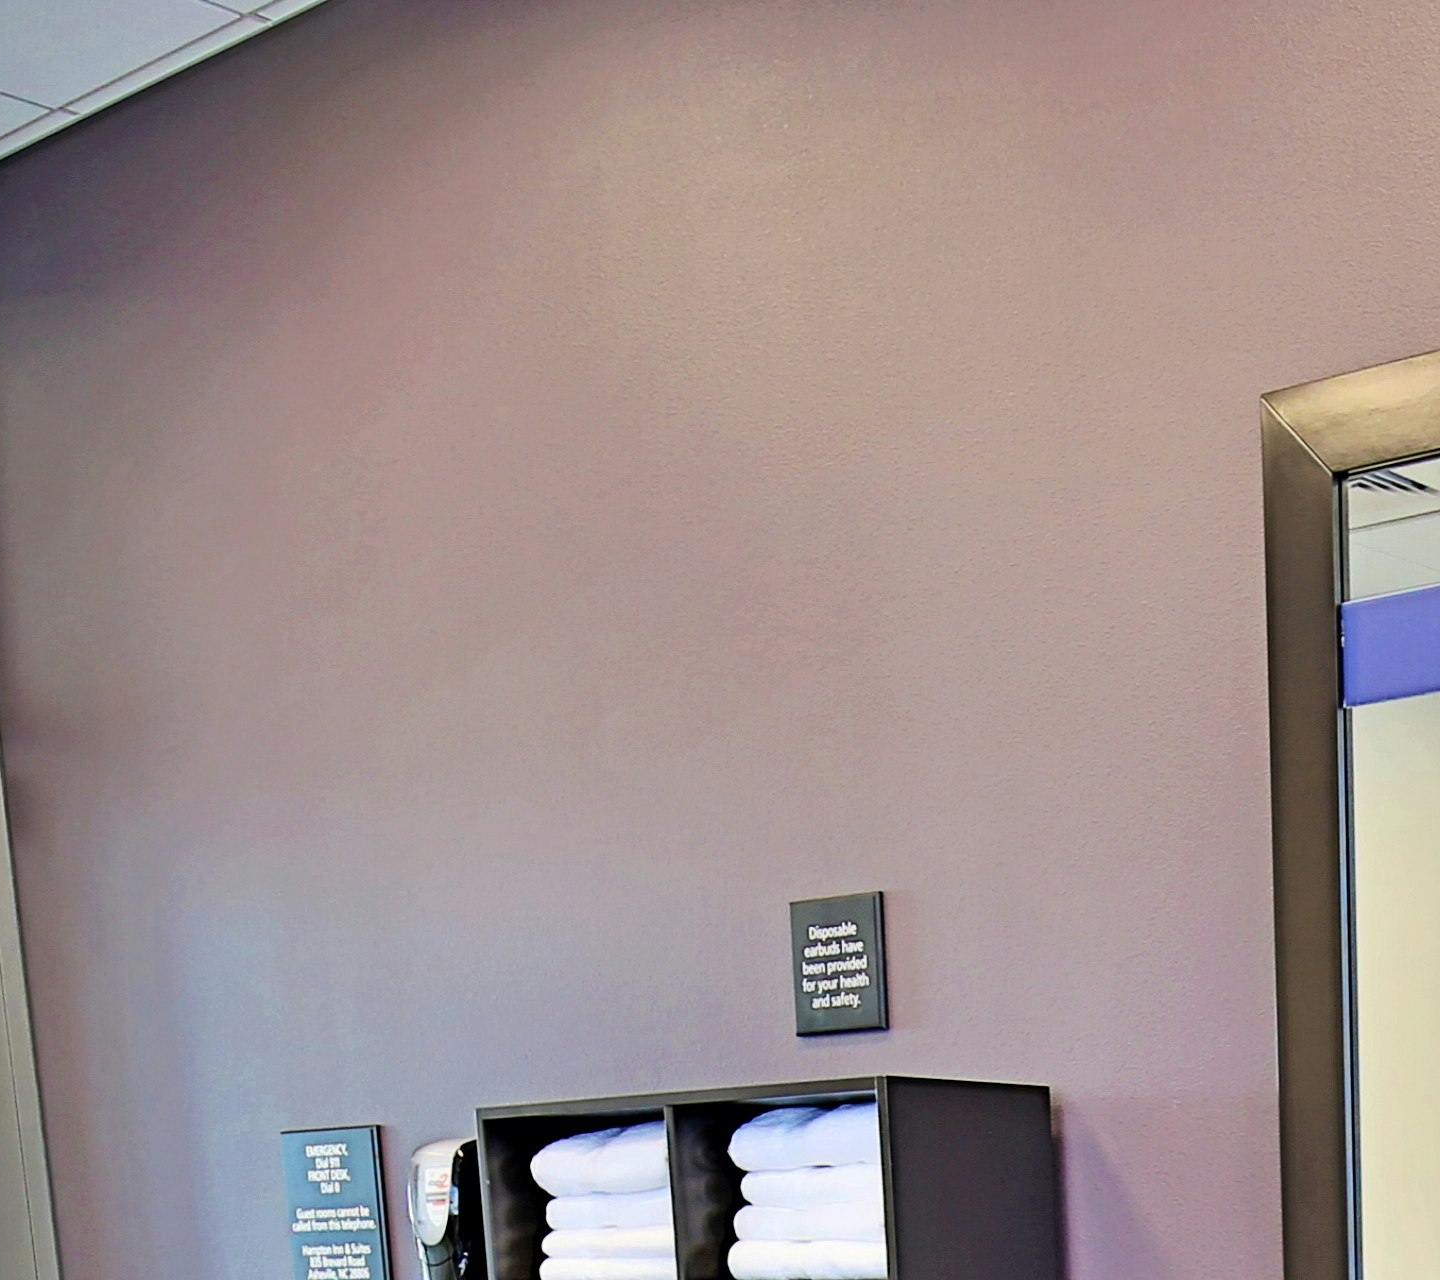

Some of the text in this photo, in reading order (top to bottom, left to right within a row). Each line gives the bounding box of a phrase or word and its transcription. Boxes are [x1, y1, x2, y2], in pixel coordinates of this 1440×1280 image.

[808, 921, 858, 942] Disposable
[804, 940, 864, 959] earbuds have
[802, 955, 868, 976] been provided
[802, 973, 870, 995] for your health
[812, 991, 861, 1009] and safety.
[305, 1143, 349, 1158] EMERGENCY,
[315, 1157, 340, 1169] Dial 911
[307, 1168, 351, 1182] FRONT DESK,
[320, 1182, 334, 1194] Dial
[296, 1205, 370, 1220] Guest rooms cannot be
[292, 1220, 311, 1232] called
[312, 1220, 328, 1231] from
[328, 1219, 341, 1230] this
[302, 1243, 371, 1257] Hampton Inn & Suites
[348, 1255, 366, 1267] Road
[307, 1268, 338, 1280] Asheville,
[338, 1267, 349, 1279] NC
